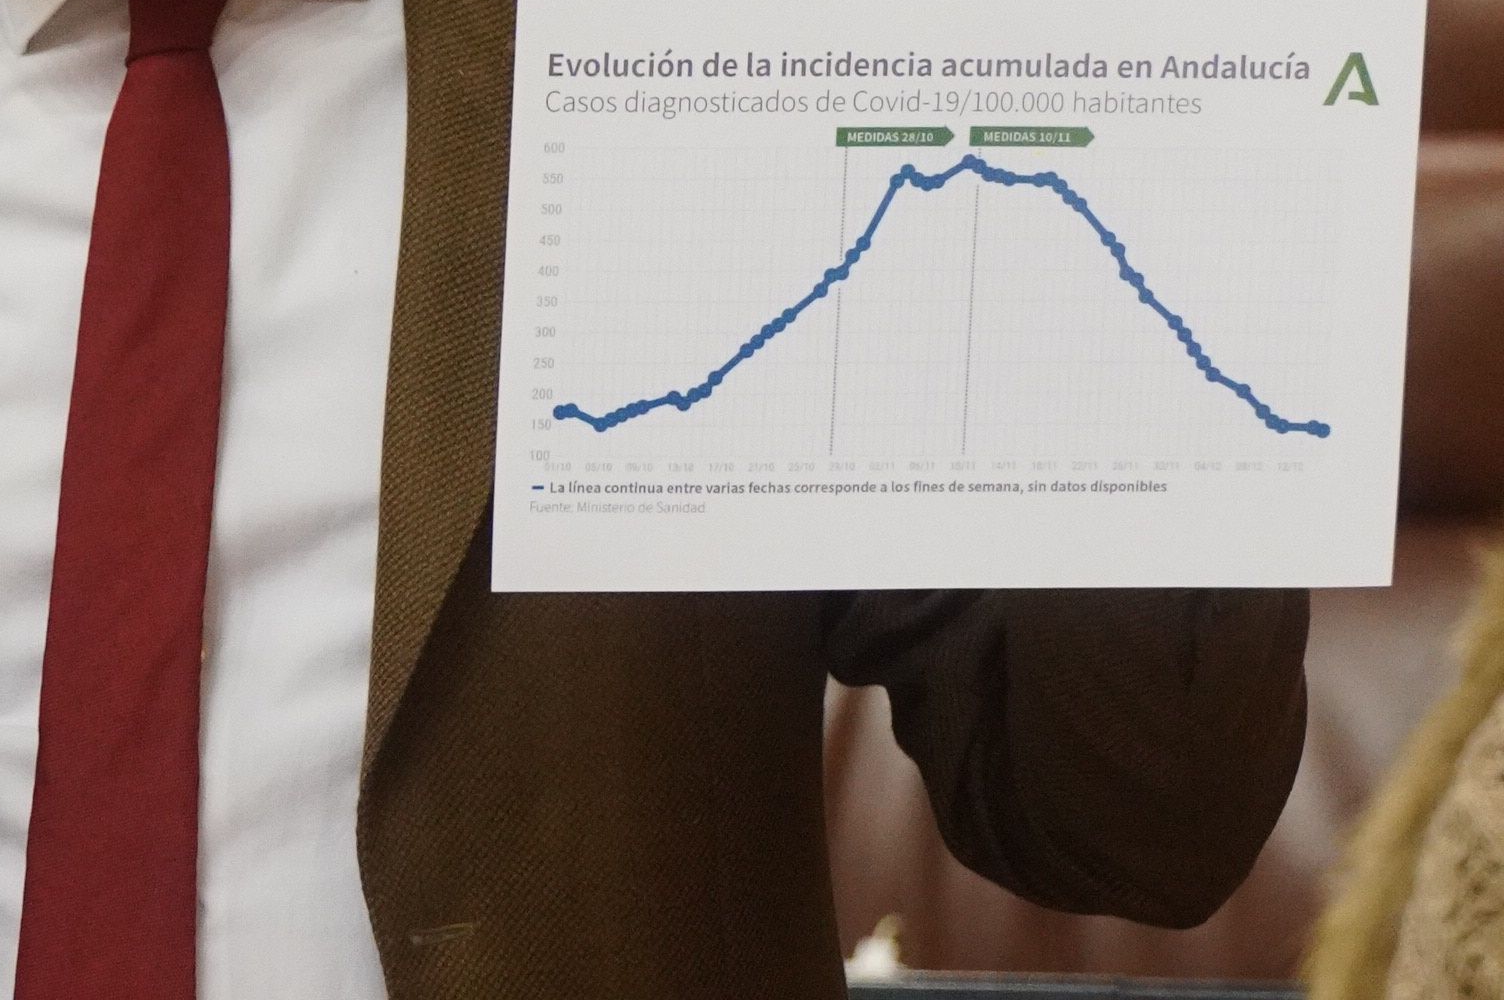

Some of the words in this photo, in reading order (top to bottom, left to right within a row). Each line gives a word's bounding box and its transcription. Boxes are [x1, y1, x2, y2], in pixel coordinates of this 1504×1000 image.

[547, 48, 693, 78] Evolución
[702, 51, 739, 78] de
[746, 51, 771, 78] la
[781, 51, 933, 79] incidencia
[942, 52, 1108, 79] acumulada
[1117, 58, 1152, 79] en
[1160, 51, 1311, 80] Andalucía
[545, 90, 617, 113] Casos
[625, 89, 808, 120] diagnosticados
[816, 89, 846, 113] de
[853, 89, 1064, 117] Covid-19/100.000
[1073, 91, 1202, 115] habitantes
[847, 132, 899, 142] MEDIDAS
[902, 132, 934, 143] 28/10
[984, 132, 1036, 142] MEDIDAS
[1039, 132, 1071, 143] 10/11
[544, 142, 565, 154] 600
[542, 173, 564, 184] 550
[541, 204, 562, 215] 500
[539, 235, 561, 246] 450
[538, 266, 559, 277] 400
[536, 296, 558, 307] 350
[535, 327, 556, 338] 300
[533, 358, 555, 369] 250
[532, 389, 553, 400] 200
[531, 419, 552, 431] 150
[530, 450, 551, 461] 100
[550, 482, 565, 493] La
[568, 481, 601, 493] línea
[604, 482, 663, 494] continua
[667, 483, 702, 494] entre
[706, 482, 745, 494] varias
[748, 481, 791, 494] fechas
[794, 481, 876, 495] corresponde
[880, 484, 888, 493] a
[891, 481, 910, 493] los
[913, 481, 945, 493] fines
[949, 481, 965, 493] de
[968, 483, 1024, 495] semana,
[1028, 480, 1046, 492] sin
[1050, 480, 1086, 492] datos
[1090, 480, 1167, 494] disponibles
[577, 502, 636, 513] Ministerio
[640, 502, 653, 513] de
[656, 502, 706, 513] Sanidad
